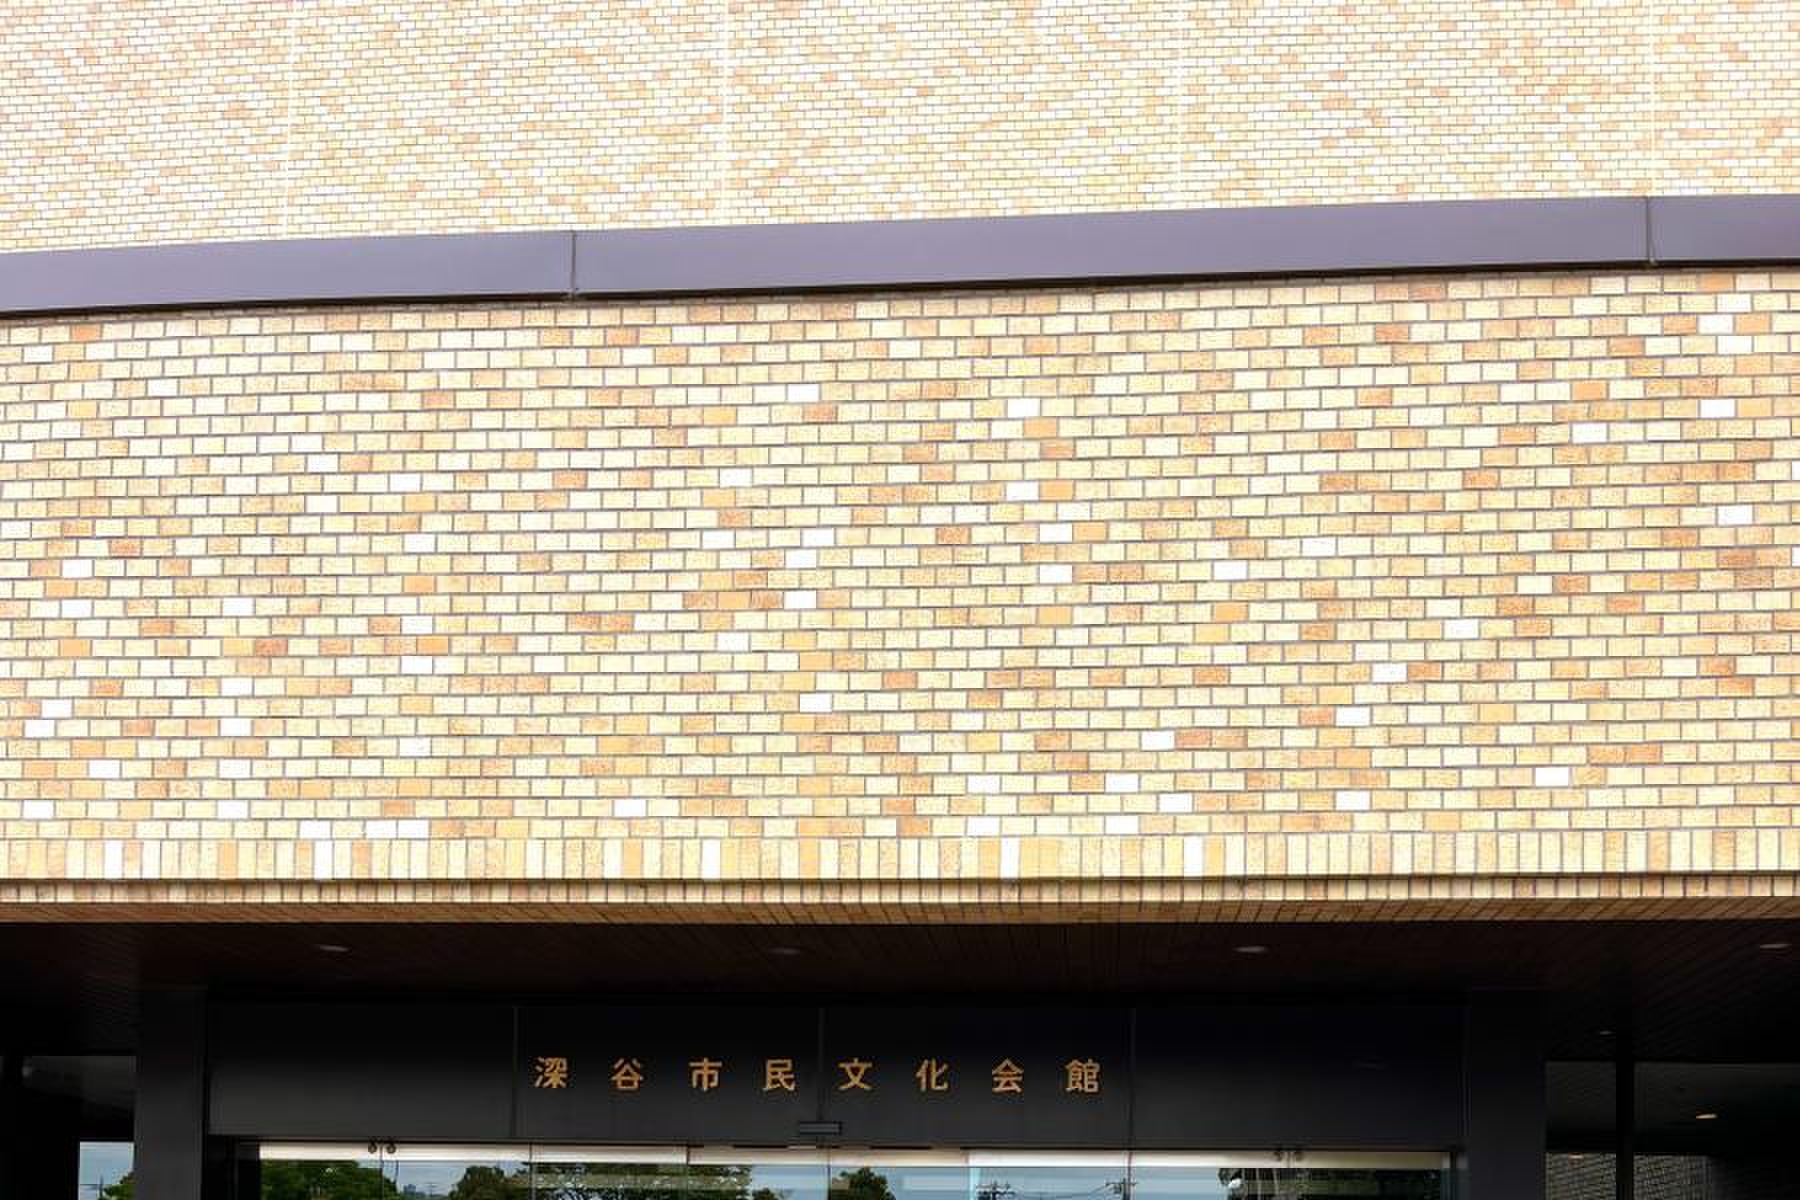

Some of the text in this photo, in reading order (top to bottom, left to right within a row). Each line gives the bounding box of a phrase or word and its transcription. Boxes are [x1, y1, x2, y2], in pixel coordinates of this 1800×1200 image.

[534, 1056, 1100, 1093] 深谷市民文化会館
